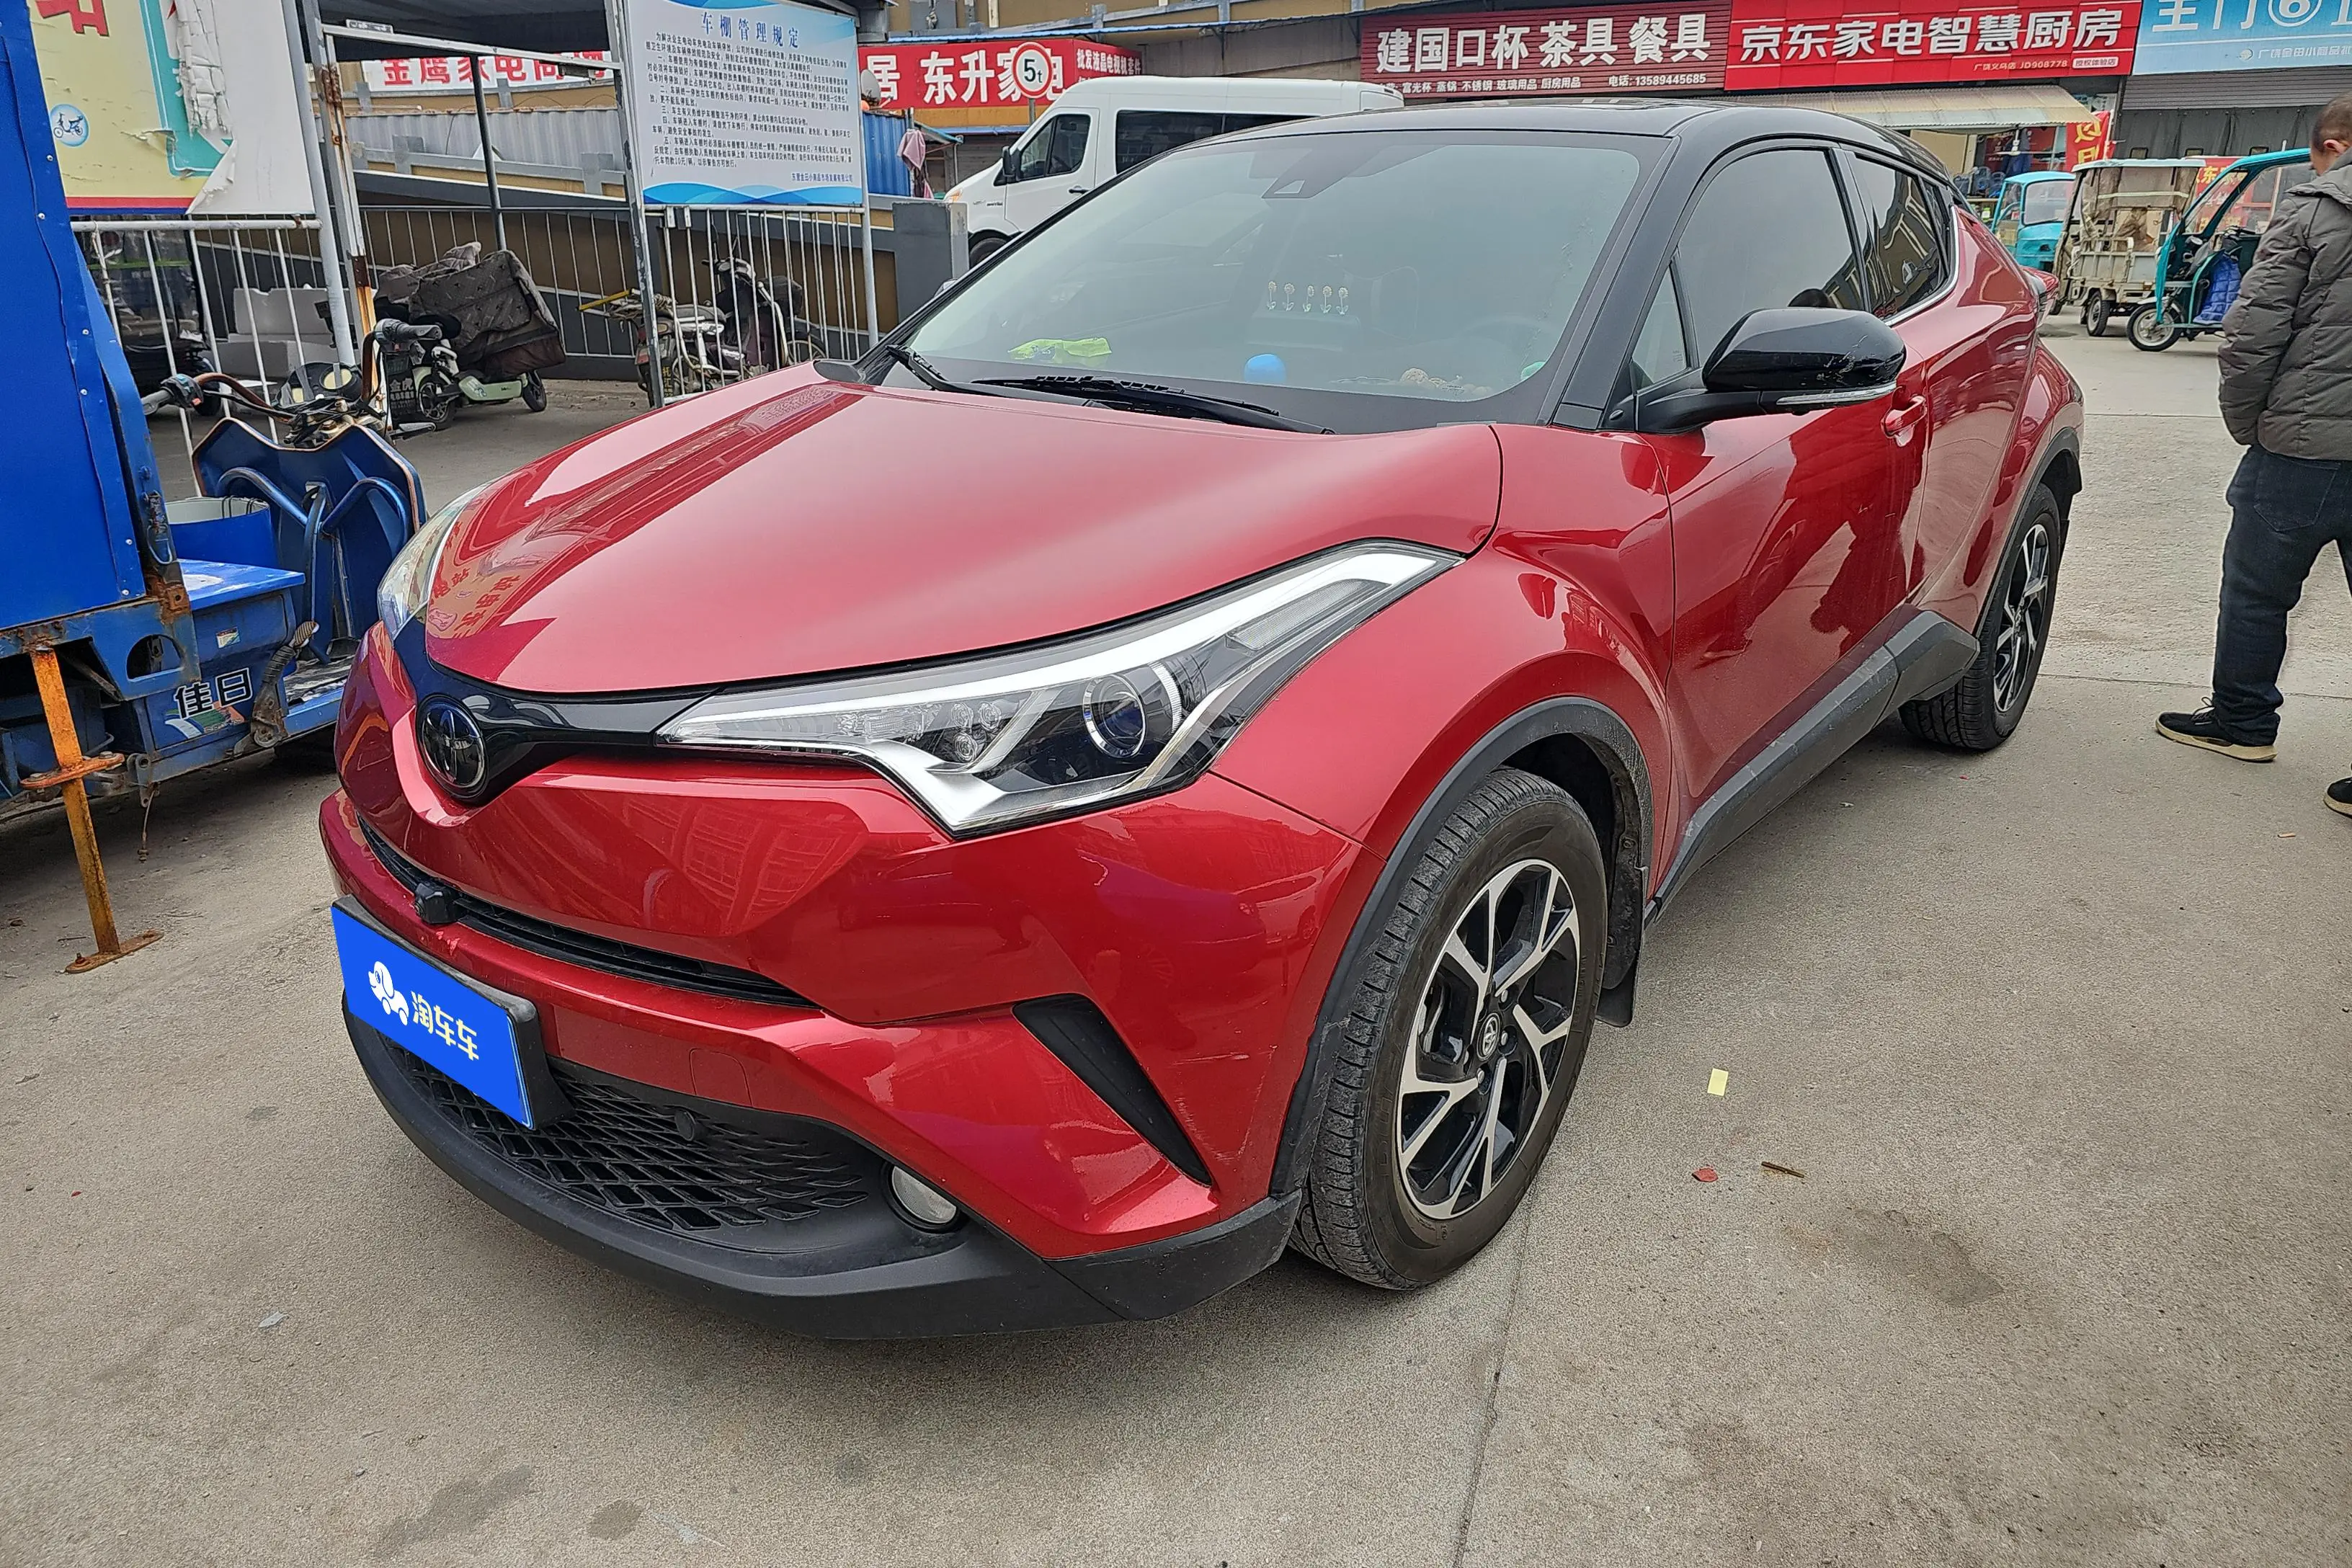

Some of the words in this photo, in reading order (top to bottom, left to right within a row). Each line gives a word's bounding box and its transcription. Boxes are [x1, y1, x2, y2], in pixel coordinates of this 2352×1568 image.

[700, 11, 799, 48] 车棚管理规定
[1740, 9, 2124, 62] 京东家电智慧厨房
[382, 51, 605, 85] 金鹰家电商
[866, 55, 901, 100] 居
[1024, 58, 1043, 83] 5t
[1974, 62, 2016, 71] 广饶义乌店
[2020, 60, 2067, 69] JD908778
[1402, 81, 1433, 94] 富光杯
[1462, 79, 1493, 92] 不锈钢
[1497, 79, 1537, 91] 玻璃用品
[1541, 77, 1581, 89] 厨房用品
